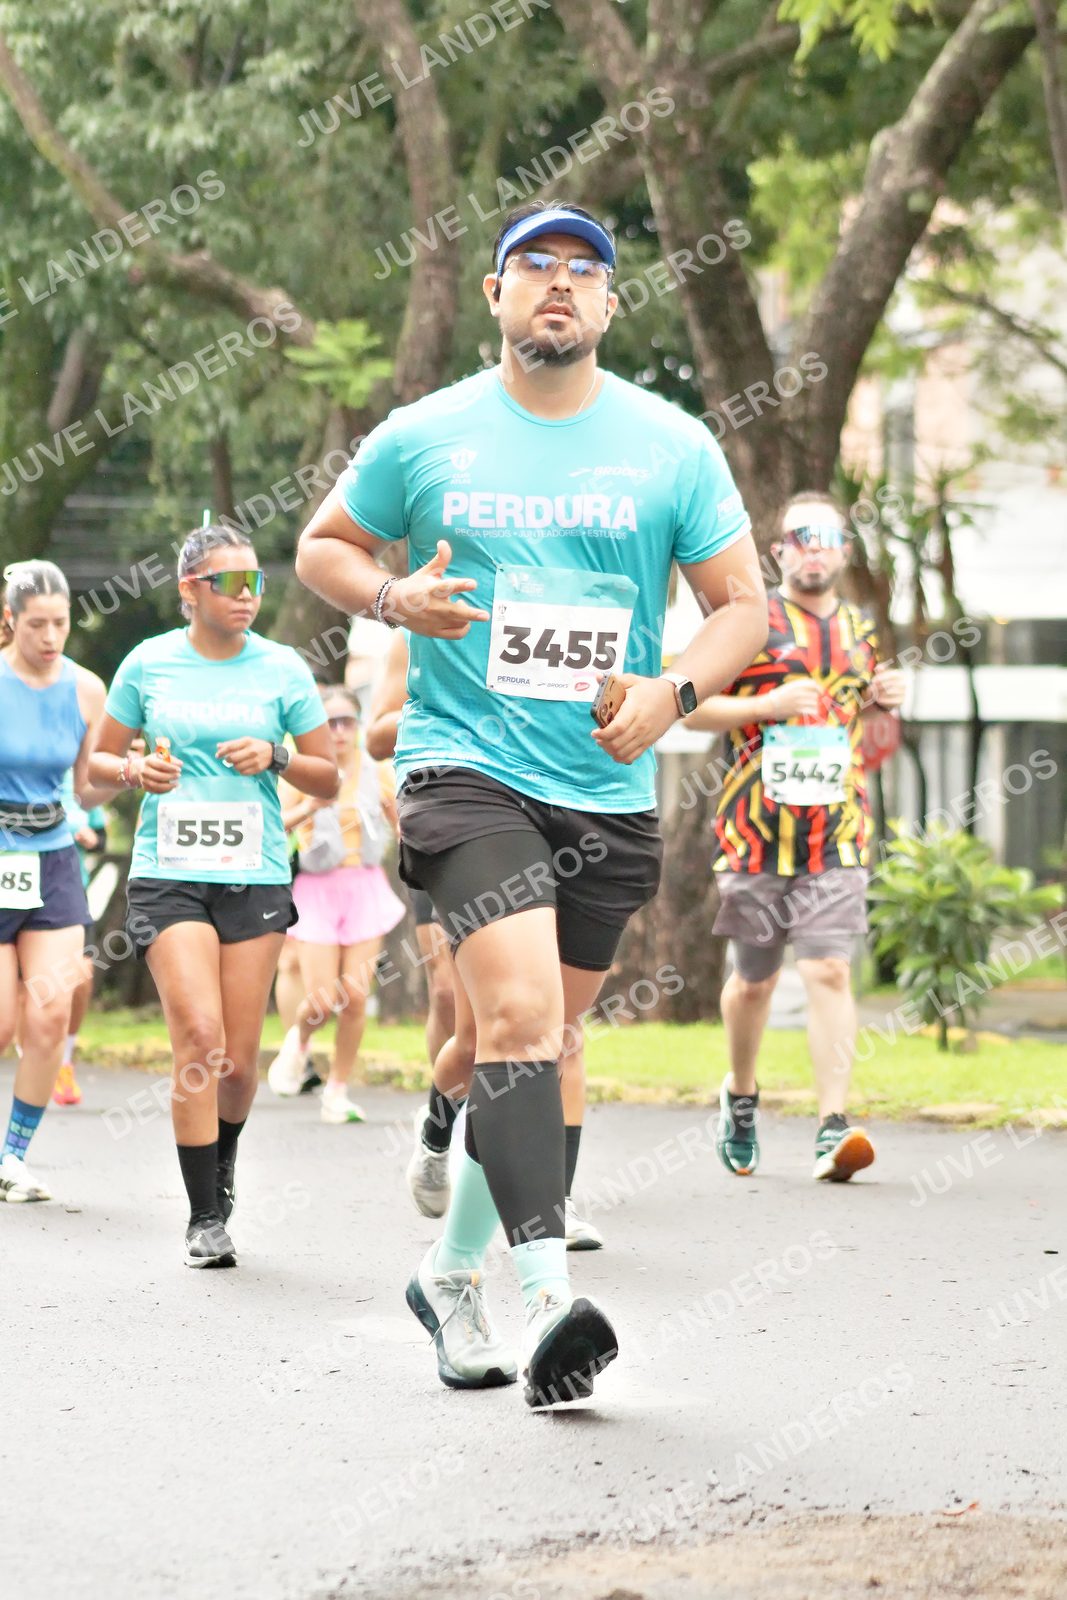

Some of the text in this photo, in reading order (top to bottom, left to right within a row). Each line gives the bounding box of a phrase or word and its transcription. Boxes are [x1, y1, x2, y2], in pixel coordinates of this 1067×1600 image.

[442, 491, 638, 532] PERDURA
[455, 527, 482, 538] PEGA
[483, 529, 512, 538] PISOS
[587, 529, 627, 540] ESTUCOS
[499, 625, 619, 670] 3455
[497, 676, 531, 685] PERDURA
[771, 762, 843, 783] 5442
[176, 820, 244, 847] 555
